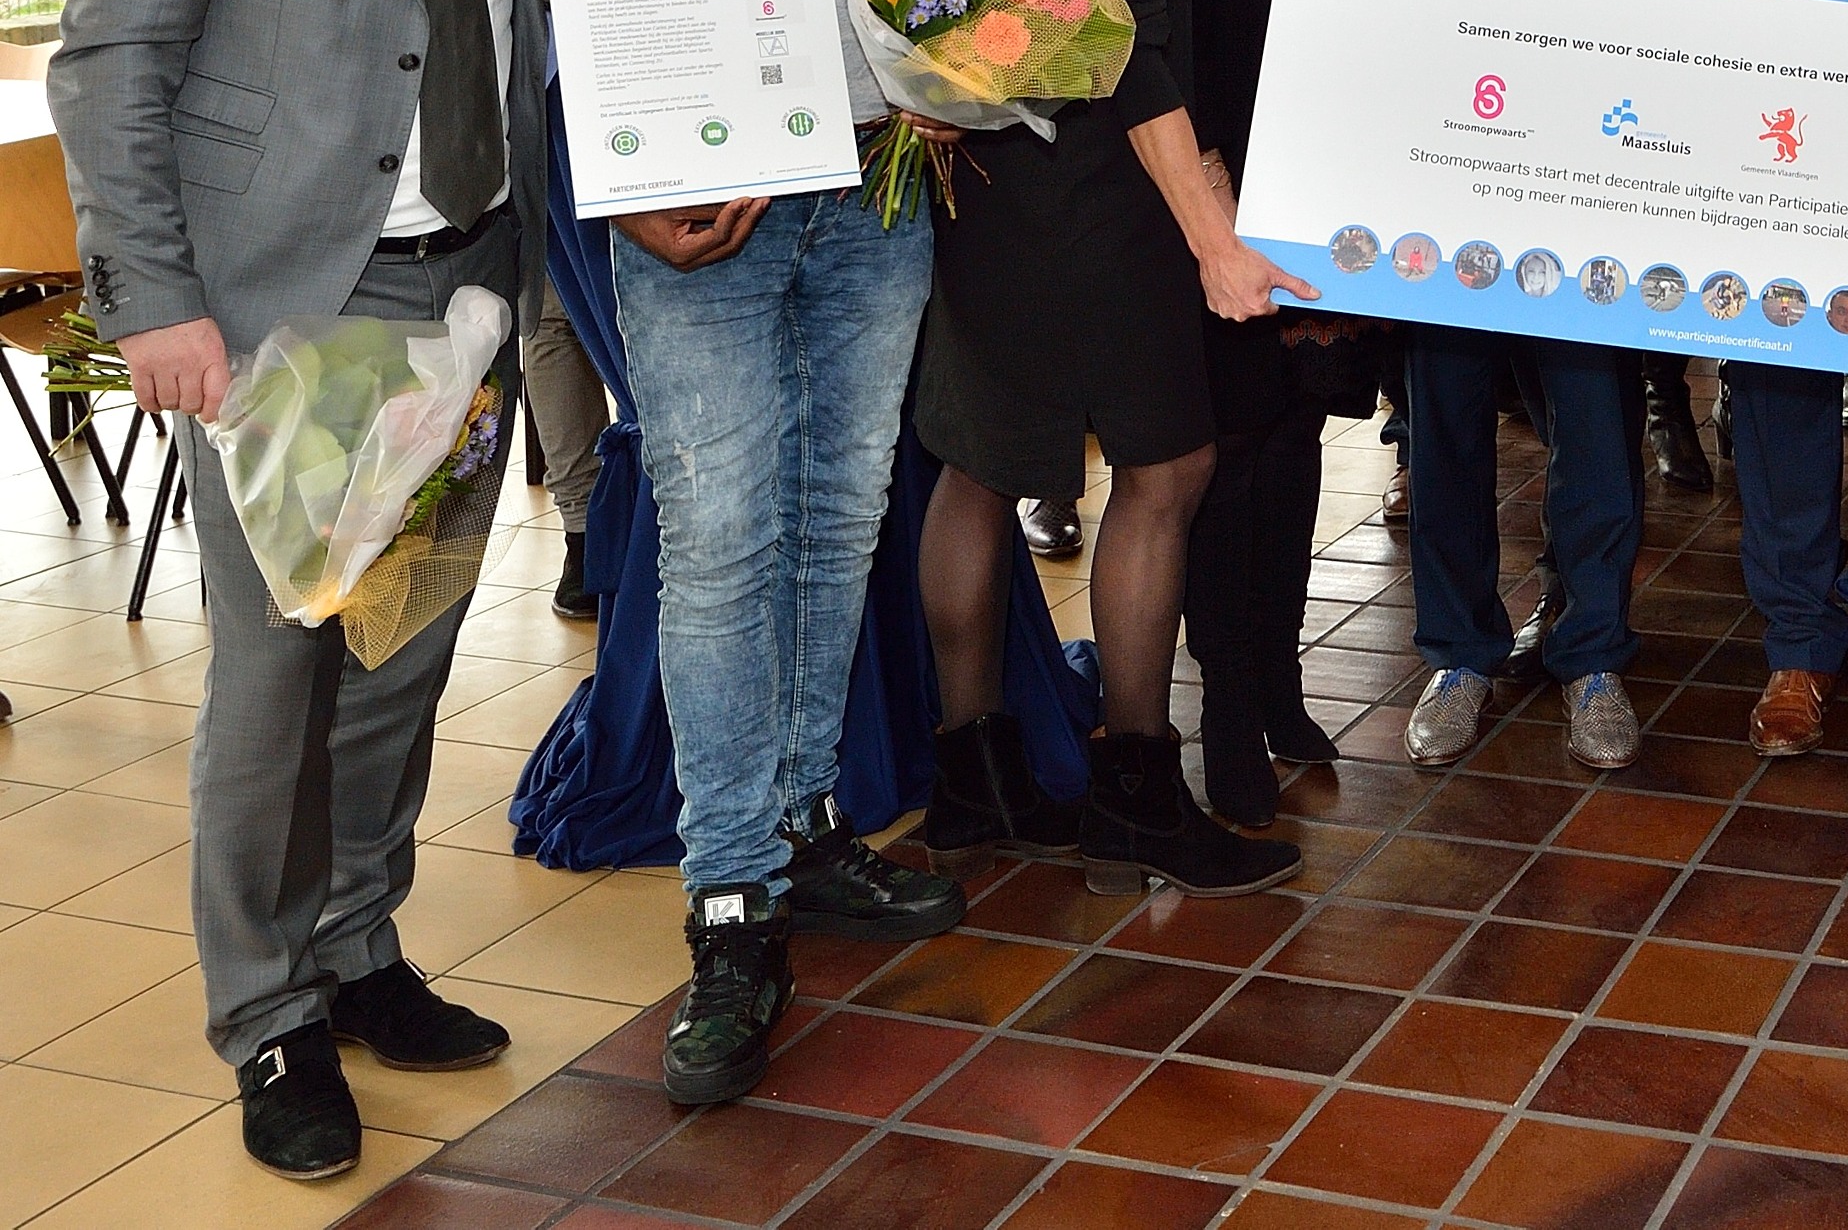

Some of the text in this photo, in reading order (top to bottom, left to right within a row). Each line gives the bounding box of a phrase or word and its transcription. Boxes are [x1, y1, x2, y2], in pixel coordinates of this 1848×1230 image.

[1457, 20, 1510, 40] Samen
[1514, 30, 1567, 48] zorgen
[1571, 38, 1594, 51] we
[1597, 42, 1633, 56] voor
[1635, 47, 1690, 63] sociale
[1693, 53, 1753, 72] cohesie
[1756, 62, 1775, 74] en
[1778, 65, 1818, 79] extra
[1442, 118, 1529, 139] Stroomopwaarts
[1621, 134, 1691, 155] Maassluis
[1408, 147, 1530, 176] Stroomopwaarts
[1534, 165, 1568, 181] start
[1571, 171, 1600, 185] met
[1604, 172, 1680, 195] decentrale
[1684, 182, 1734, 202] uitgifte
[1737, 192, 1763, 205] van
[1768, 192, 1848, 215] Participatie
[1740, 164, 1818, 181] Gemeente Vlaardingen
[609, 179, 683, 193] PARTICIPATIE CERTIFICAAT
[1471, 182, 1491, 197] op
[1495, 185, 1524, 202] nog
[1527, 189, 1566, 204] meer
[1569, 195, 1638, 213] manieren
[1642, 200, 1696, 221] kunnen
[1700, 207, 1767, 230] bijdragen
[1771, 219, 1798, 233] aan
[1648, 327, 1792, 351] www.participatiecertificaat.nl
